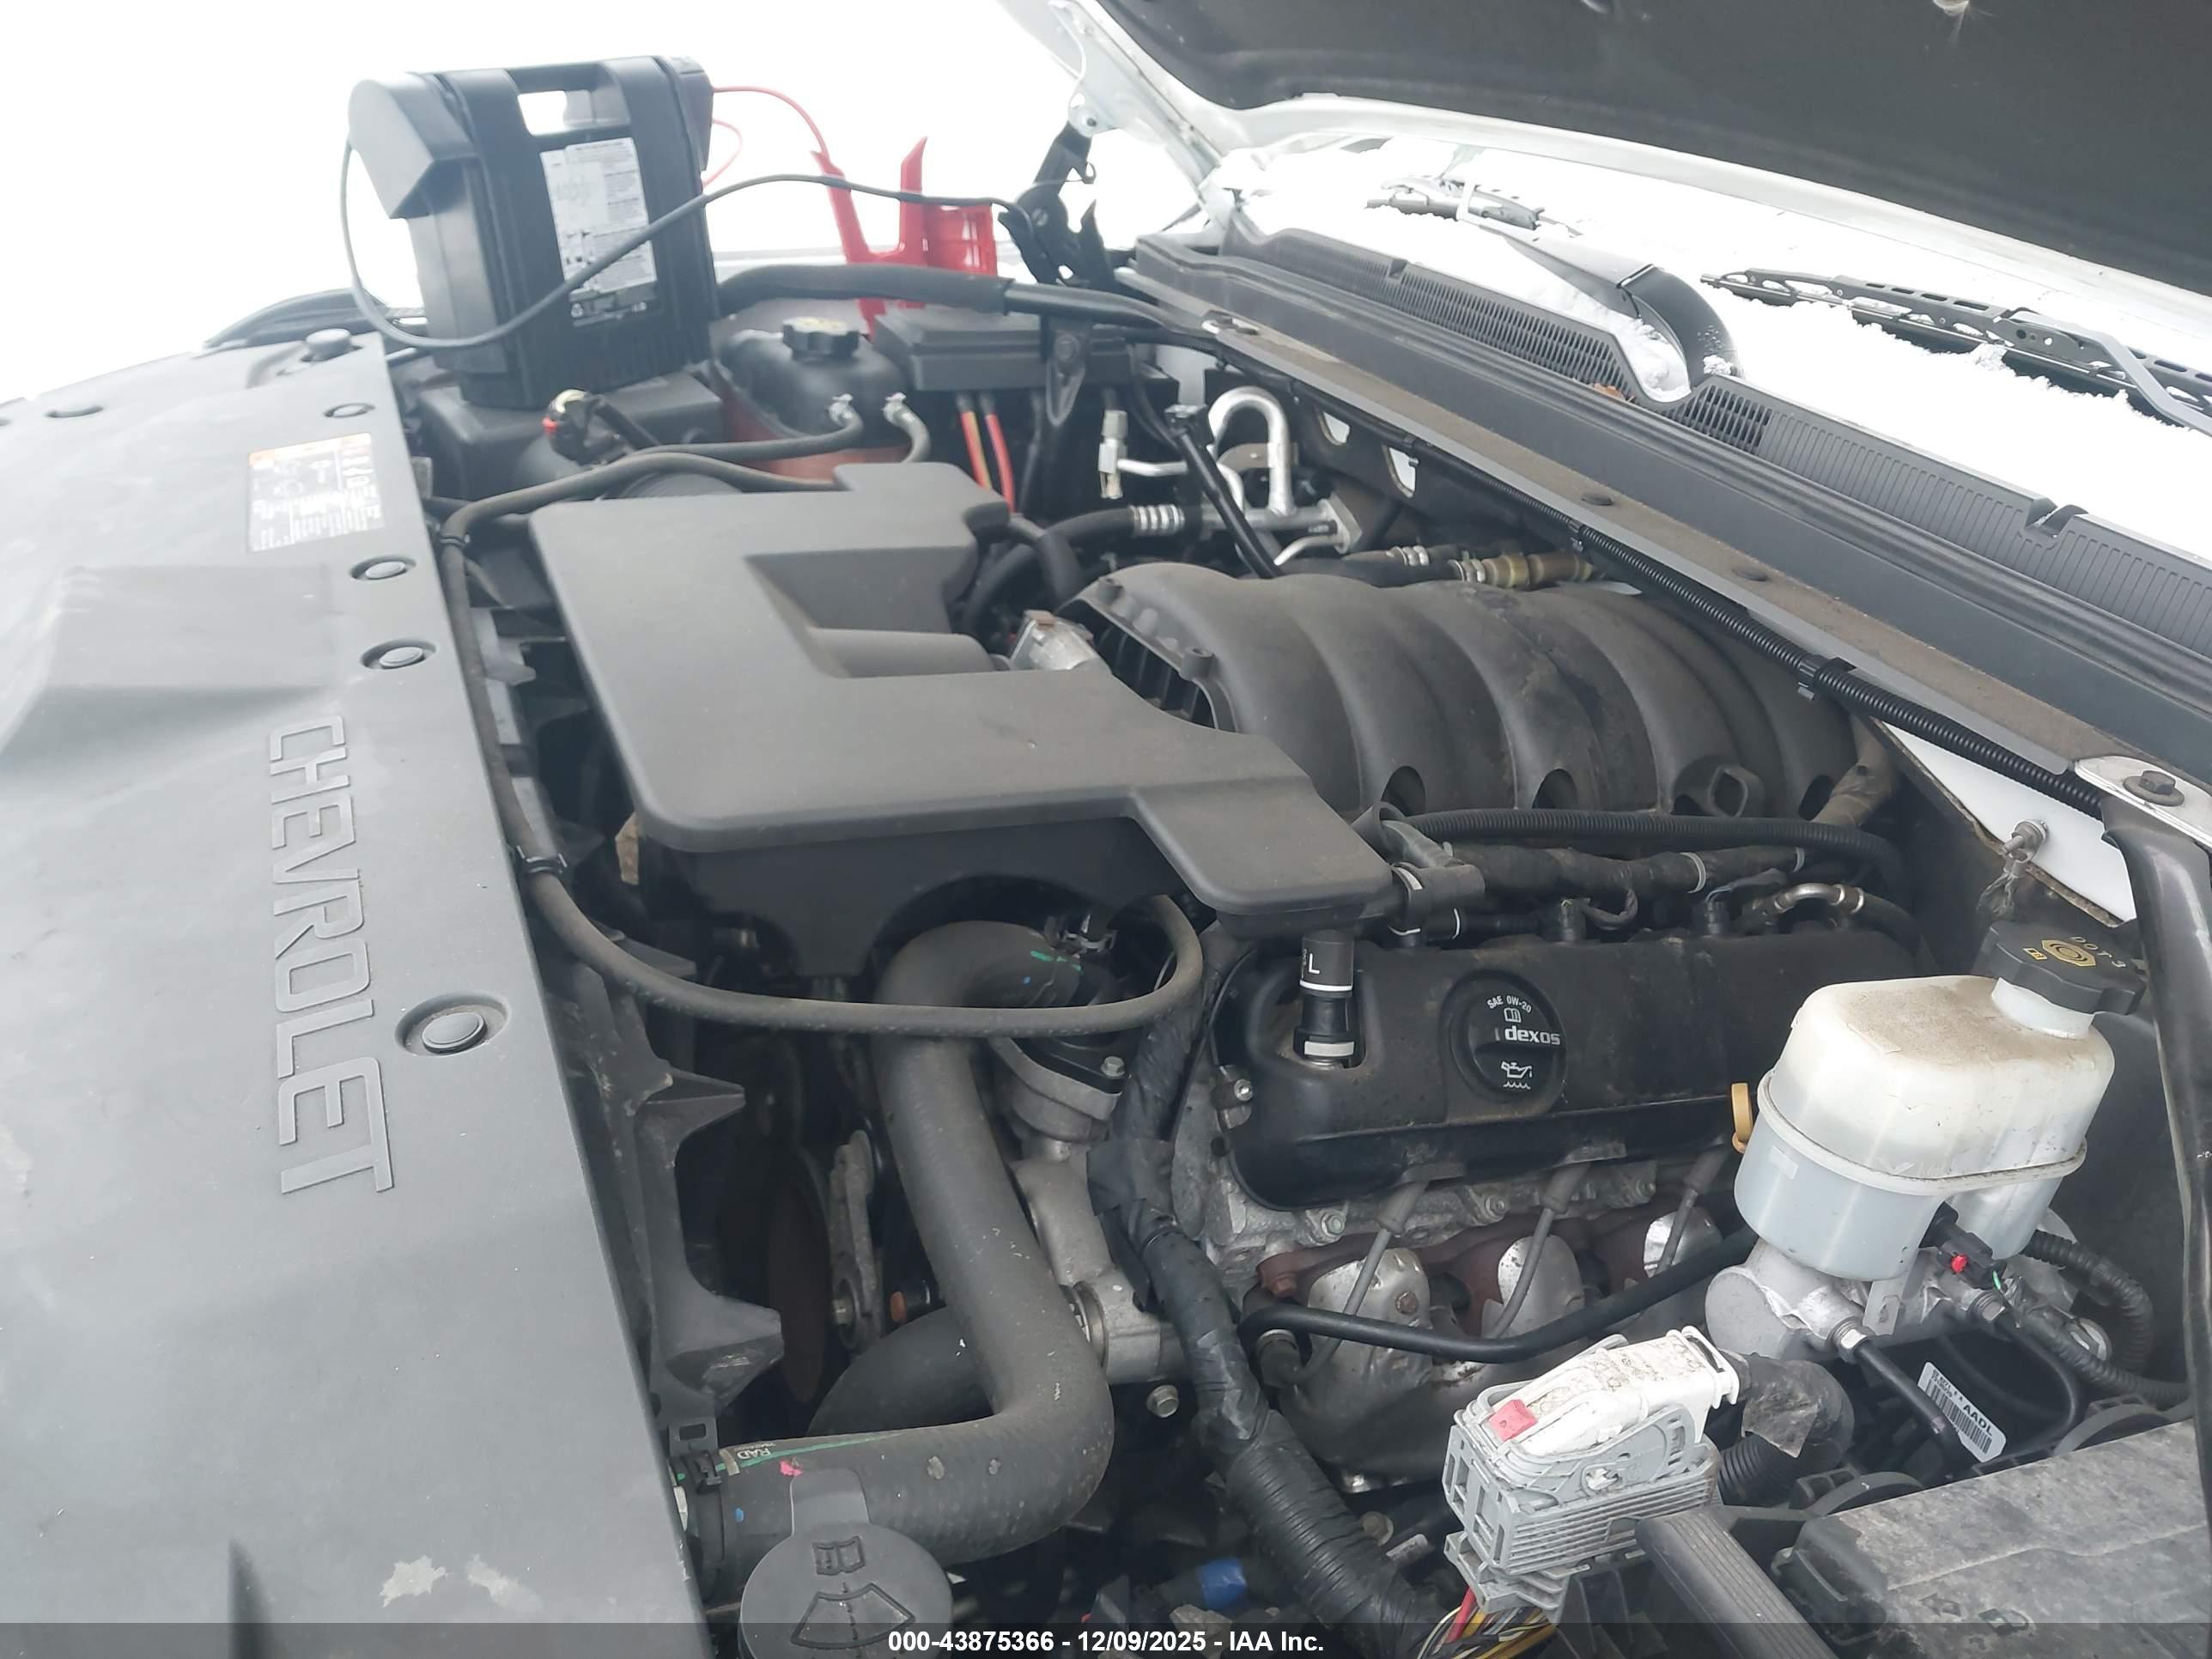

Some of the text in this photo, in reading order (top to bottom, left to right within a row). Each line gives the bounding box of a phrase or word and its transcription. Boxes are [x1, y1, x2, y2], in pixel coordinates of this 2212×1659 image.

[270, 714, 395, 1194] CHEVROLET
[1308, 952, 1321, 975] L
[1487, 995, 1532, 1013] SAE 0W-20
[1504, 1025, 1561, 1046] dexos
[1962, 1404, 1993, 1437] AADL
[737, 1448, 771, 1460] RAD
